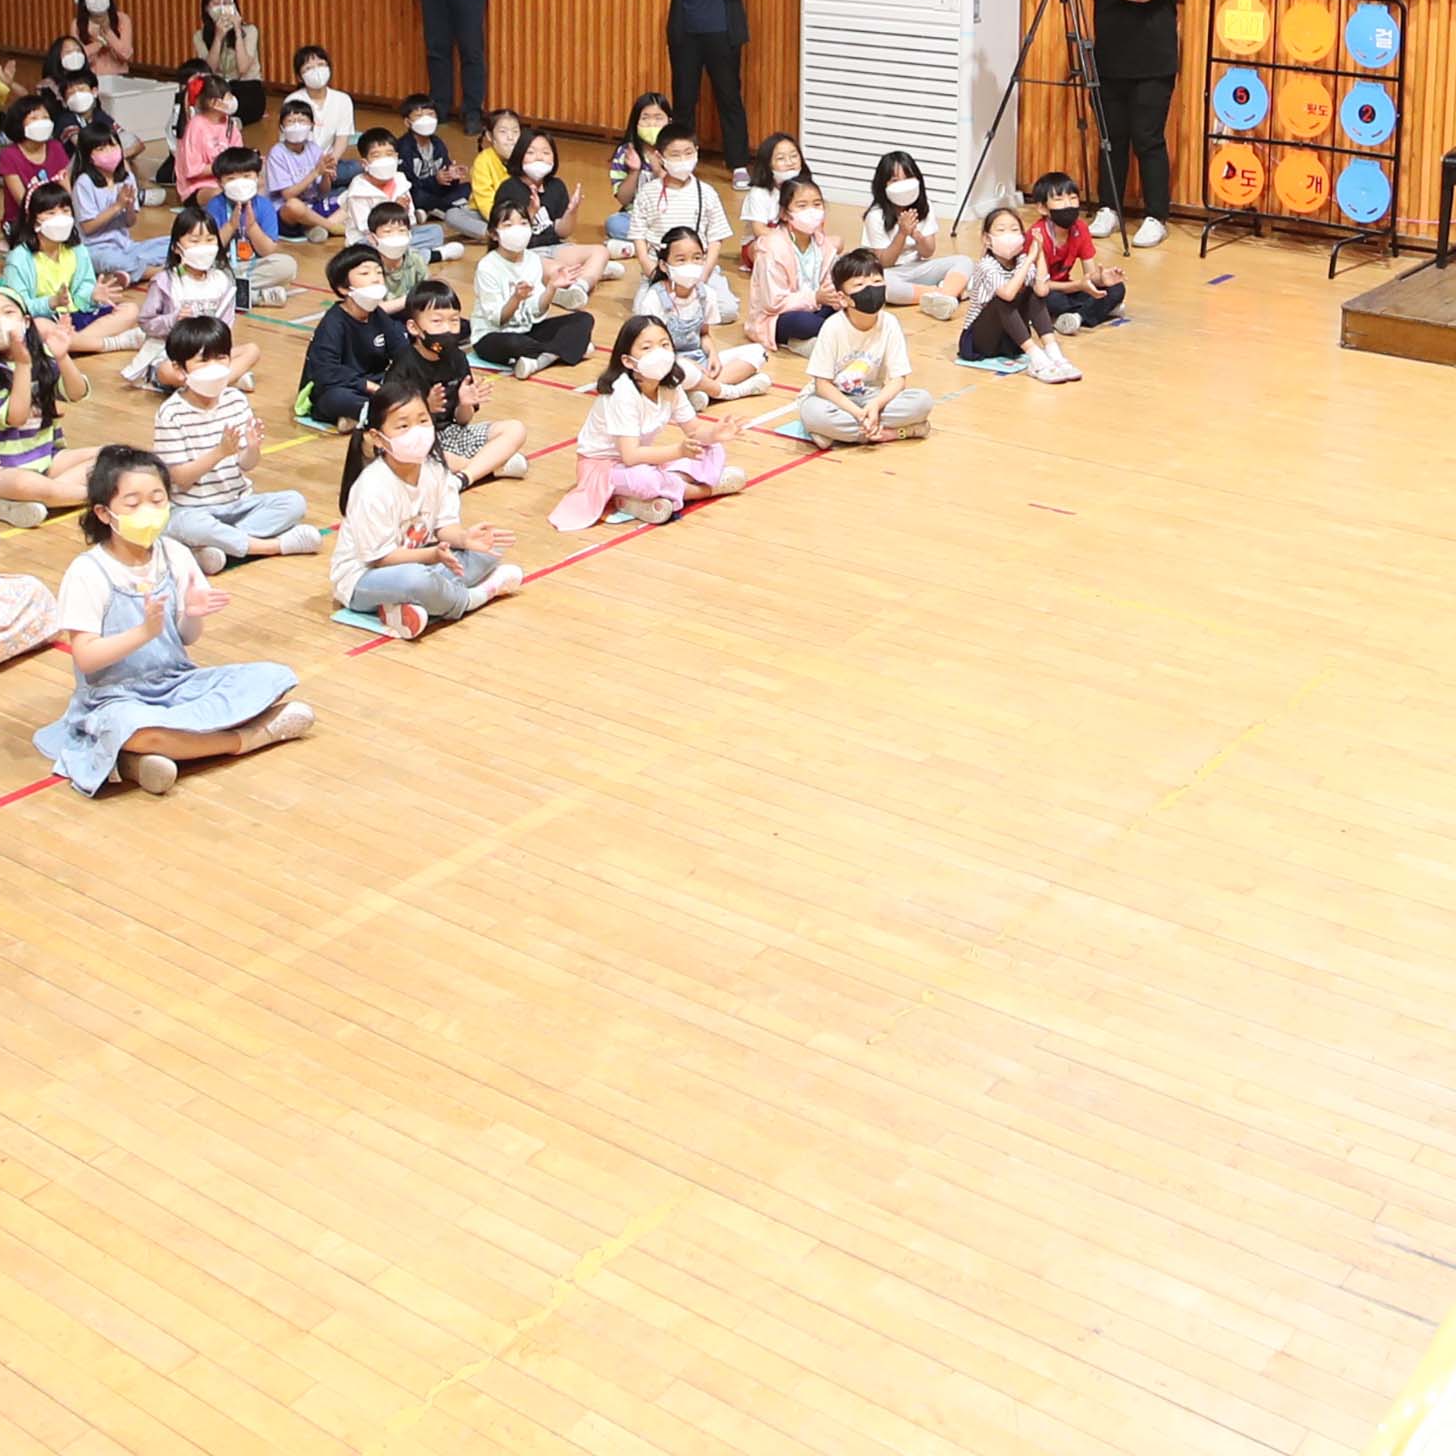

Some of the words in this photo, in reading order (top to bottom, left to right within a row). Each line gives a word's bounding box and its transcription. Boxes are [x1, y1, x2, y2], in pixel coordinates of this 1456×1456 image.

[1236, 88, 1248, 104] 5
[1362, 105, 1373, 122] 2
[1240, 169, 1257, 188] 도
[1306, 174, 1323, 194] 개
